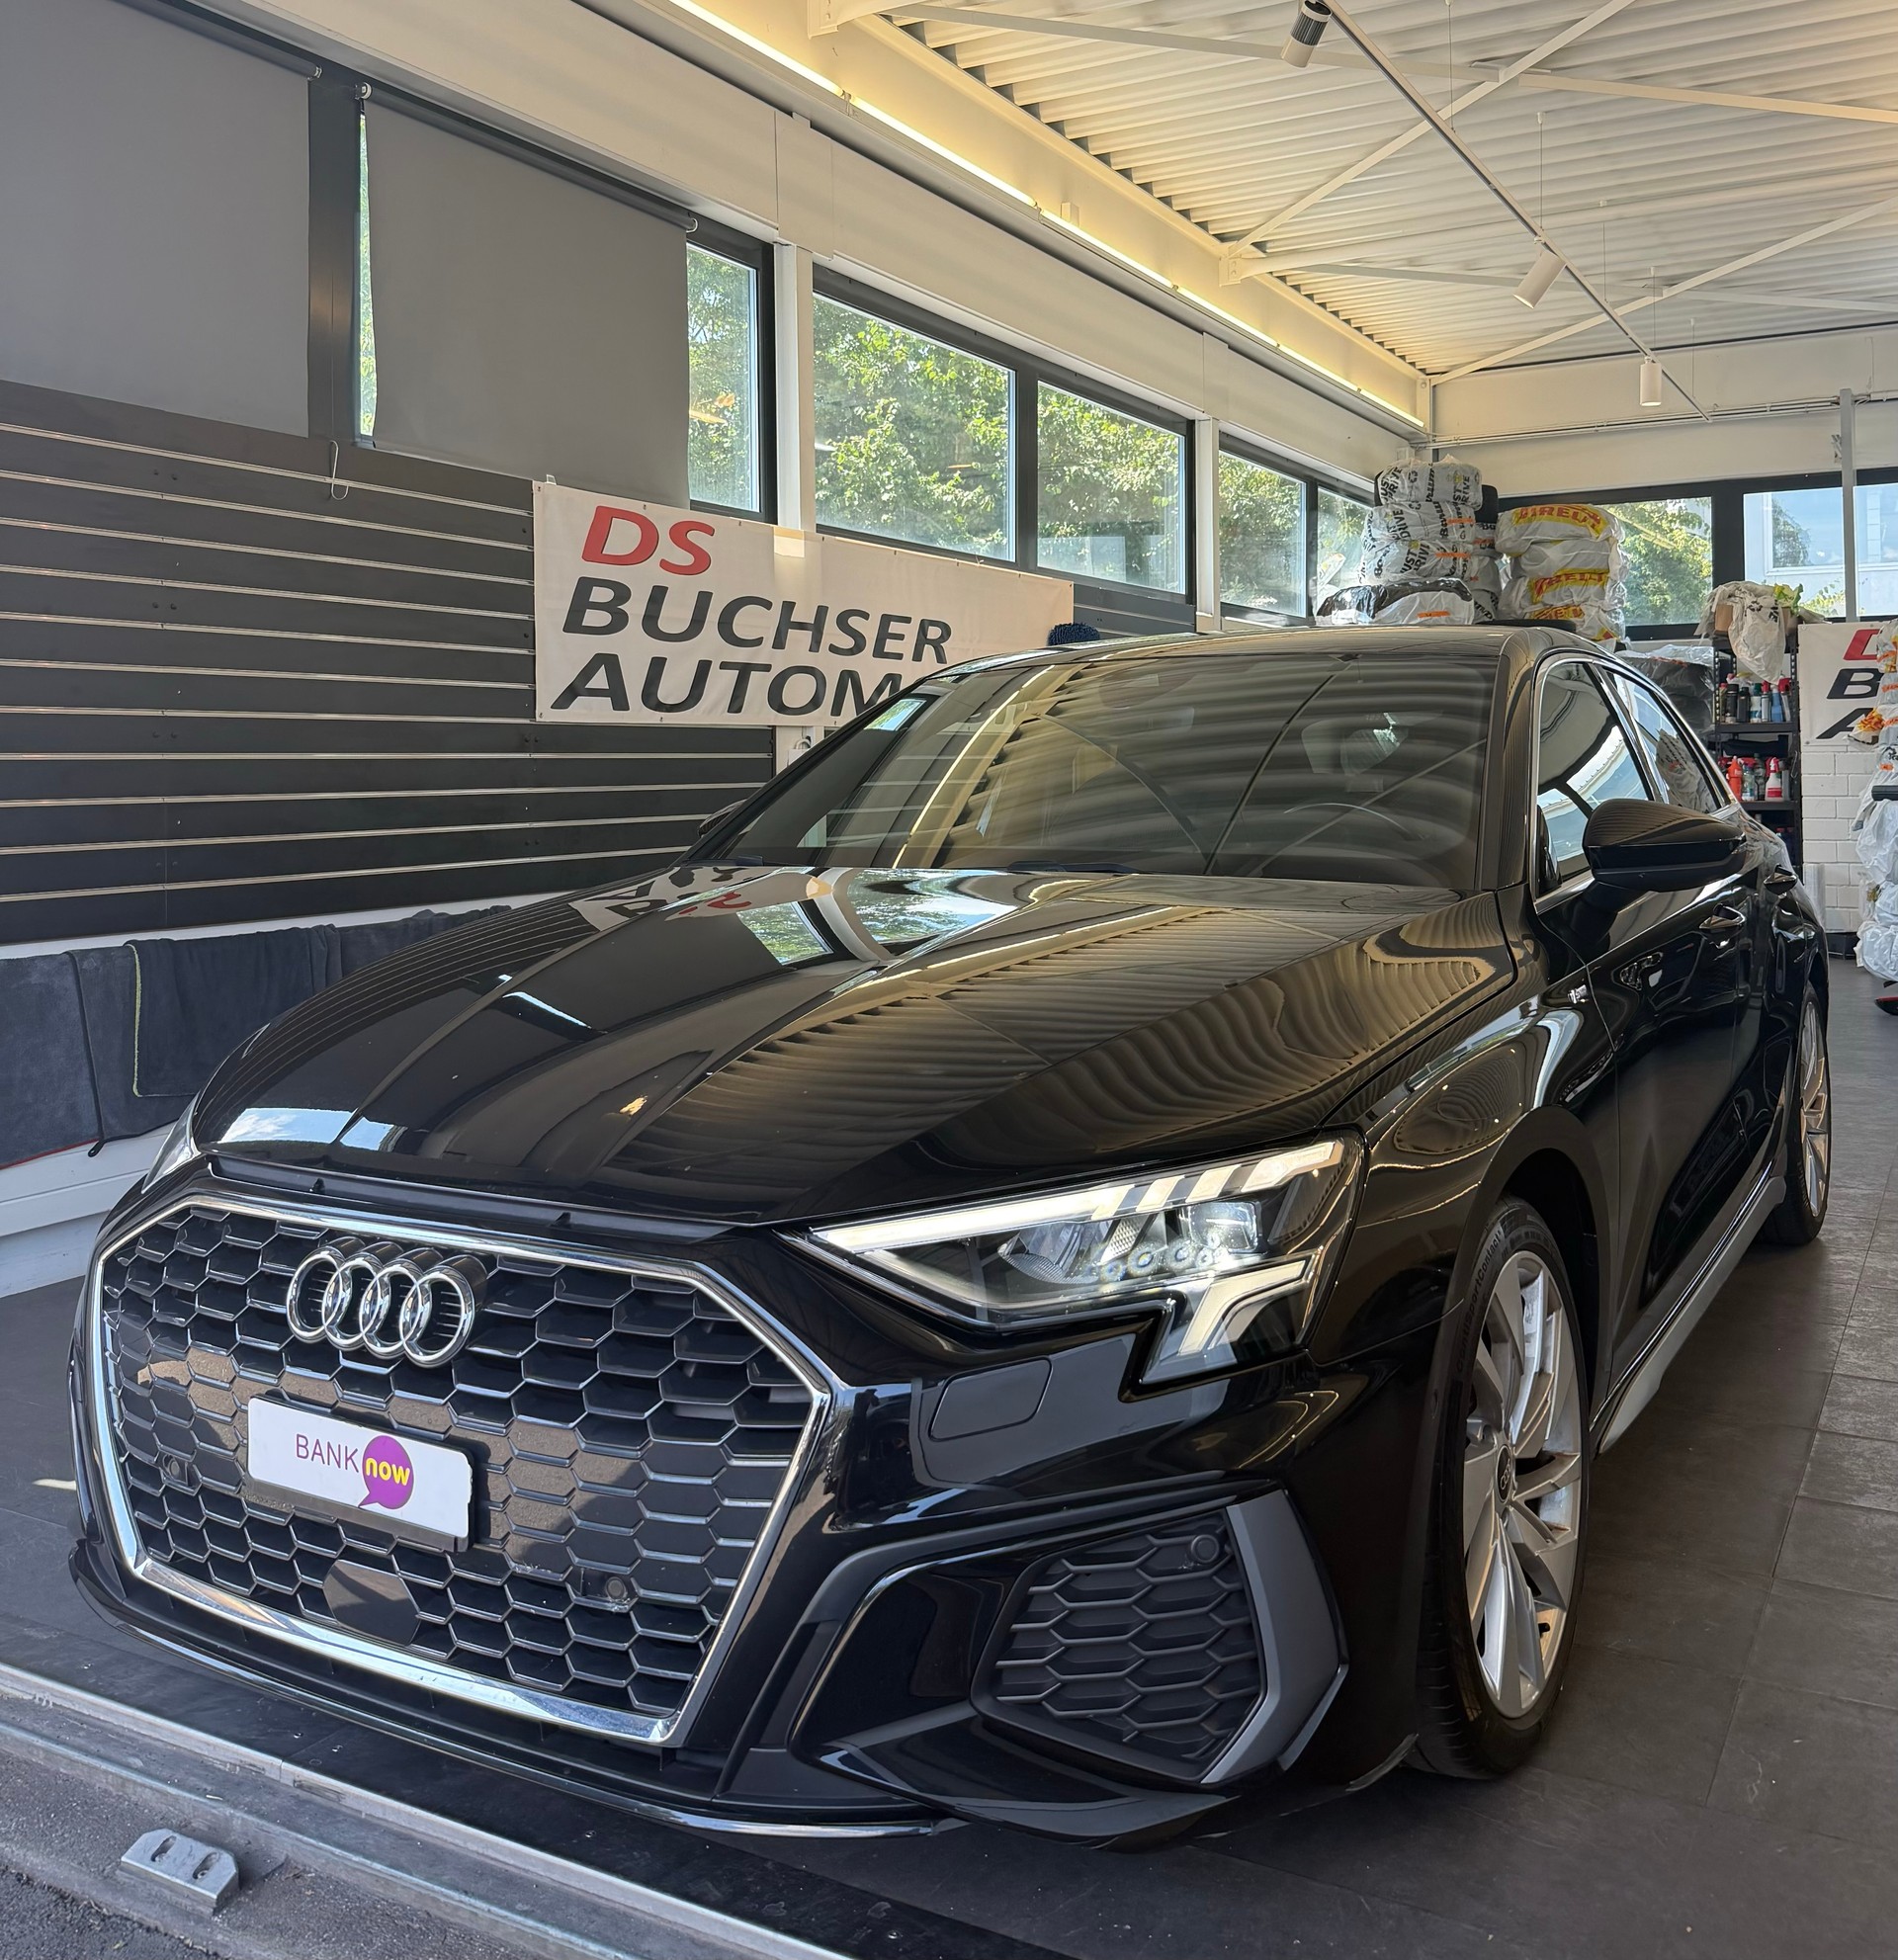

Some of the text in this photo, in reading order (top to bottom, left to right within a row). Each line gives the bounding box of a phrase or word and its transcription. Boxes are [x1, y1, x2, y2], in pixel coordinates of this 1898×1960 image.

[581, 505, 715, 576] DS
[561, 576, 952, 664] BUCHSER
[296, 1433, 411, 1487] BANK now
